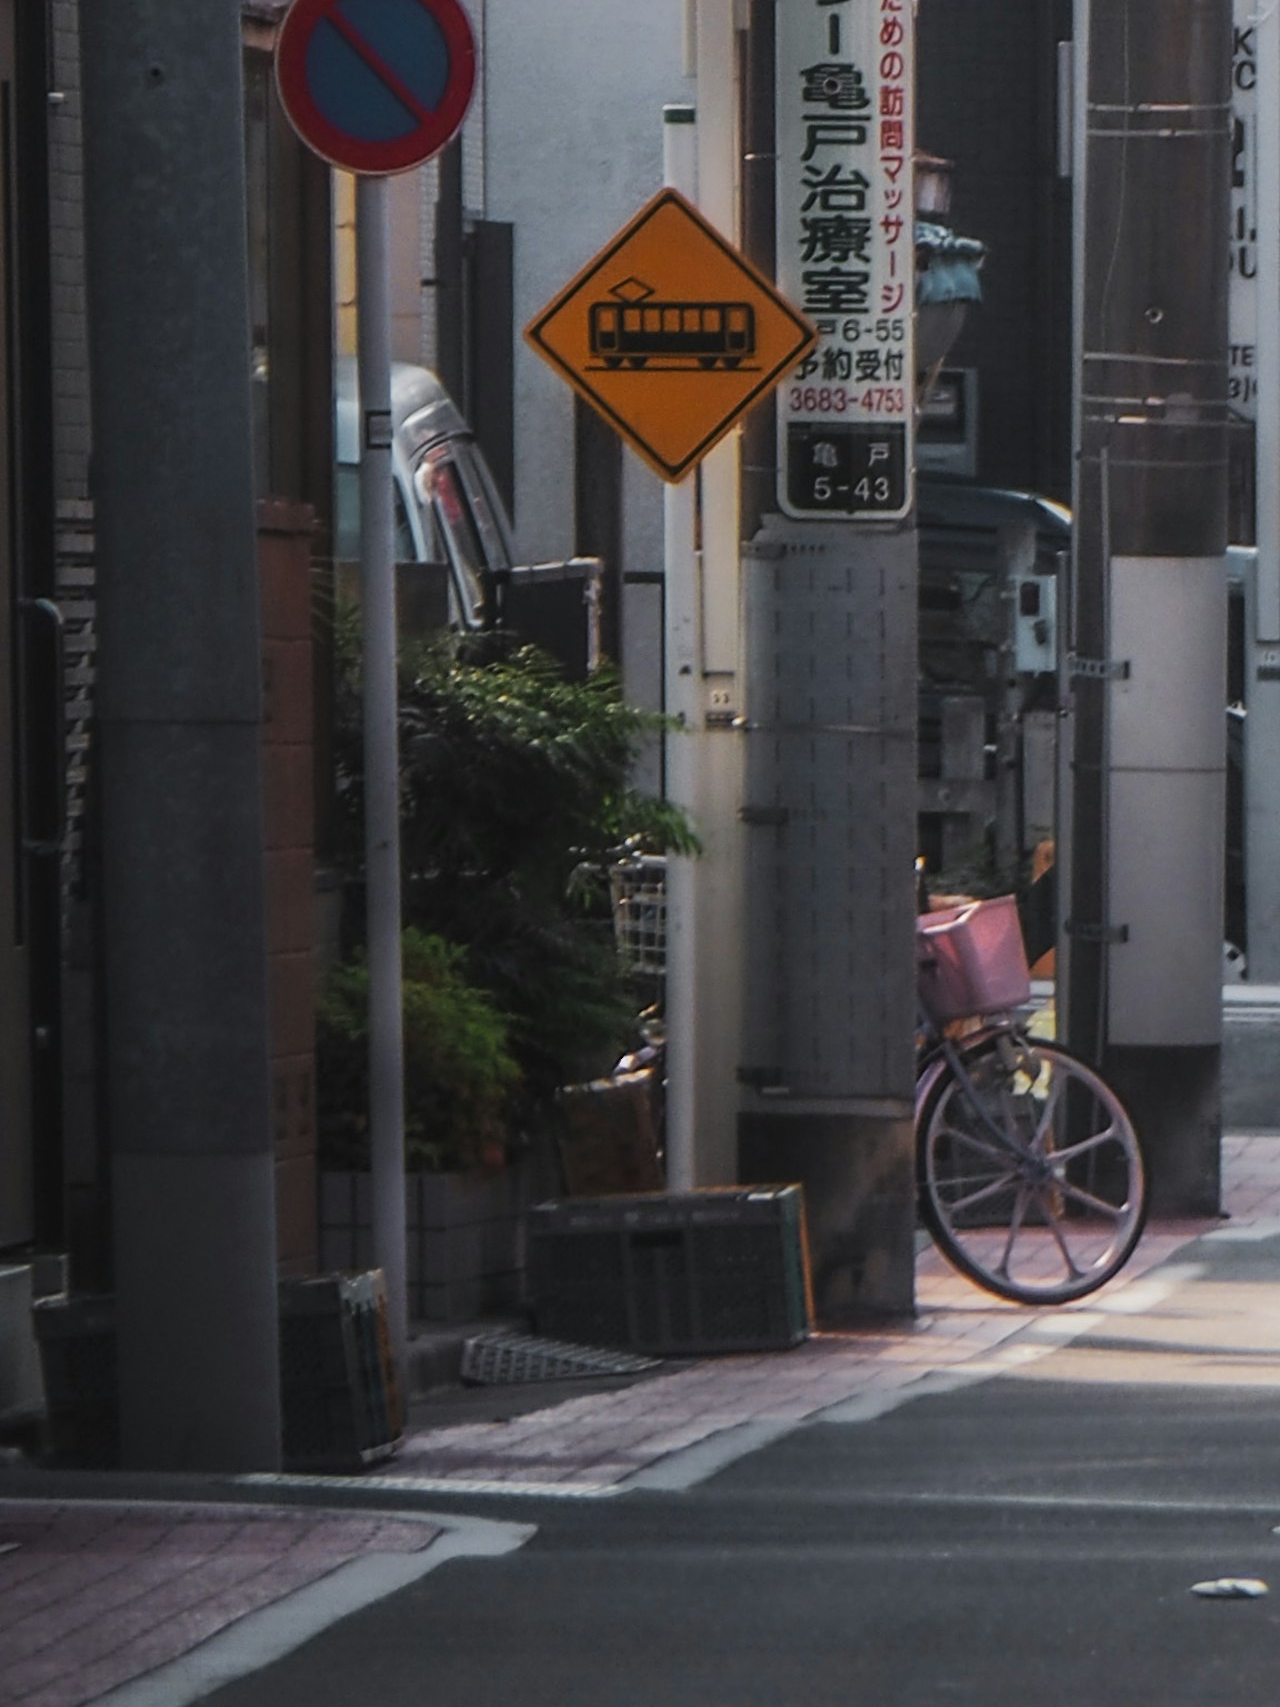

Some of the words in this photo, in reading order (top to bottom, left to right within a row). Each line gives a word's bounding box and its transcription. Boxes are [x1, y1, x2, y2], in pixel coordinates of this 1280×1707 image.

[790, 387, 904, 413] 3683-4753
[812, 441, 890, 468] 亀戸
[813, 476, 890, 501] 5-43
